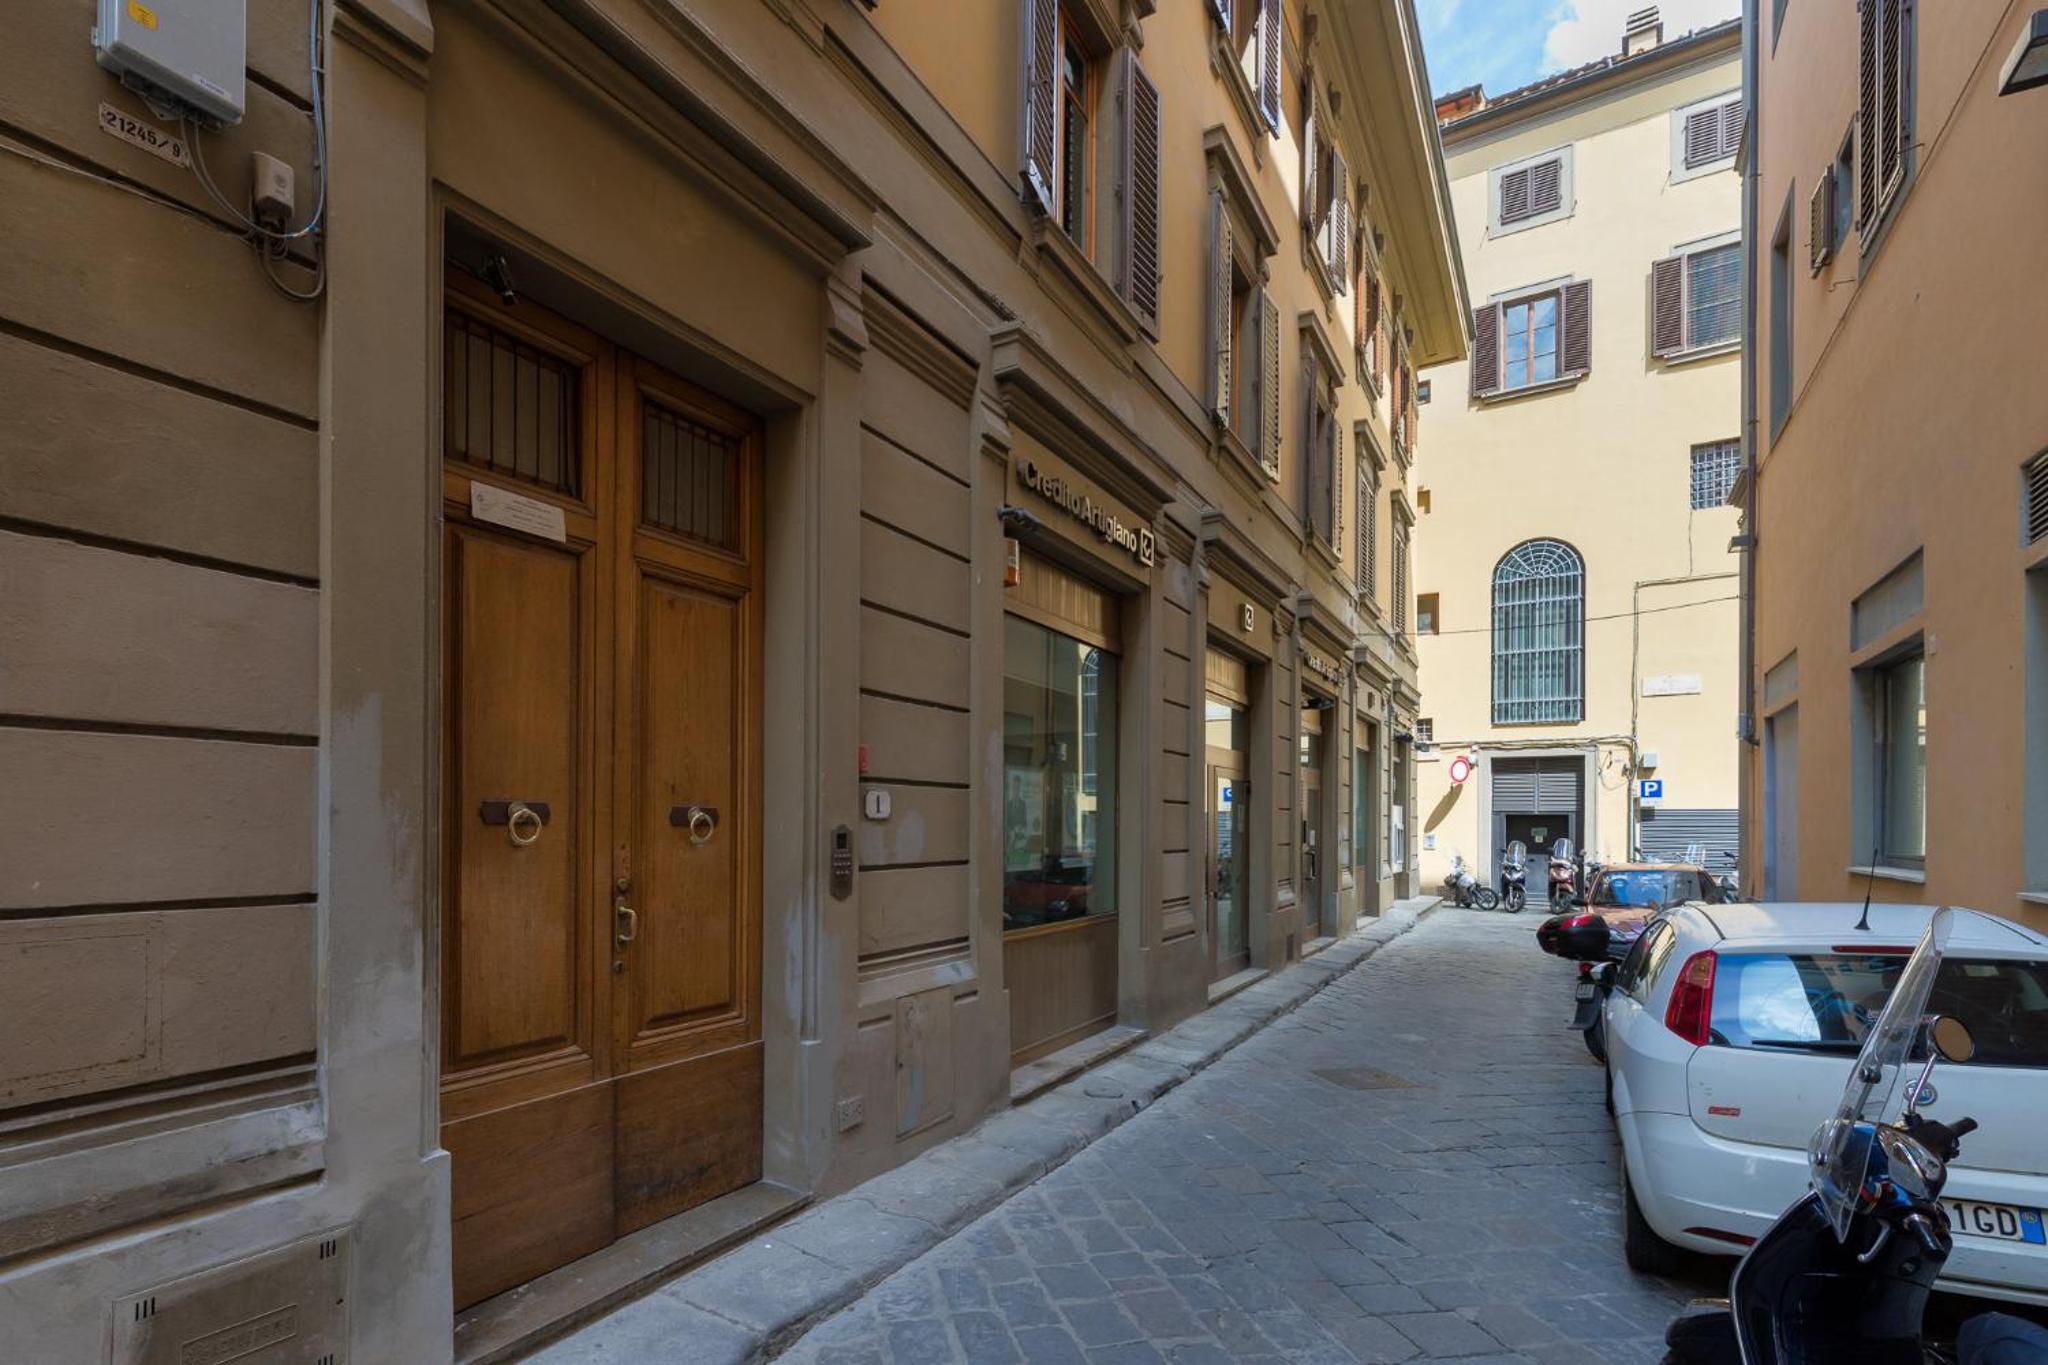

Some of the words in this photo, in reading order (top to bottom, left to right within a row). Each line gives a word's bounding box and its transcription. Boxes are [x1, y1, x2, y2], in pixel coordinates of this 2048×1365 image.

[105, 111, 182, 158] 21245/9
[1024, 459, 1080, 515] Credito
[1081, 496, 1137, 553] Artigiano
[1643, 781, 1659, 797] P
